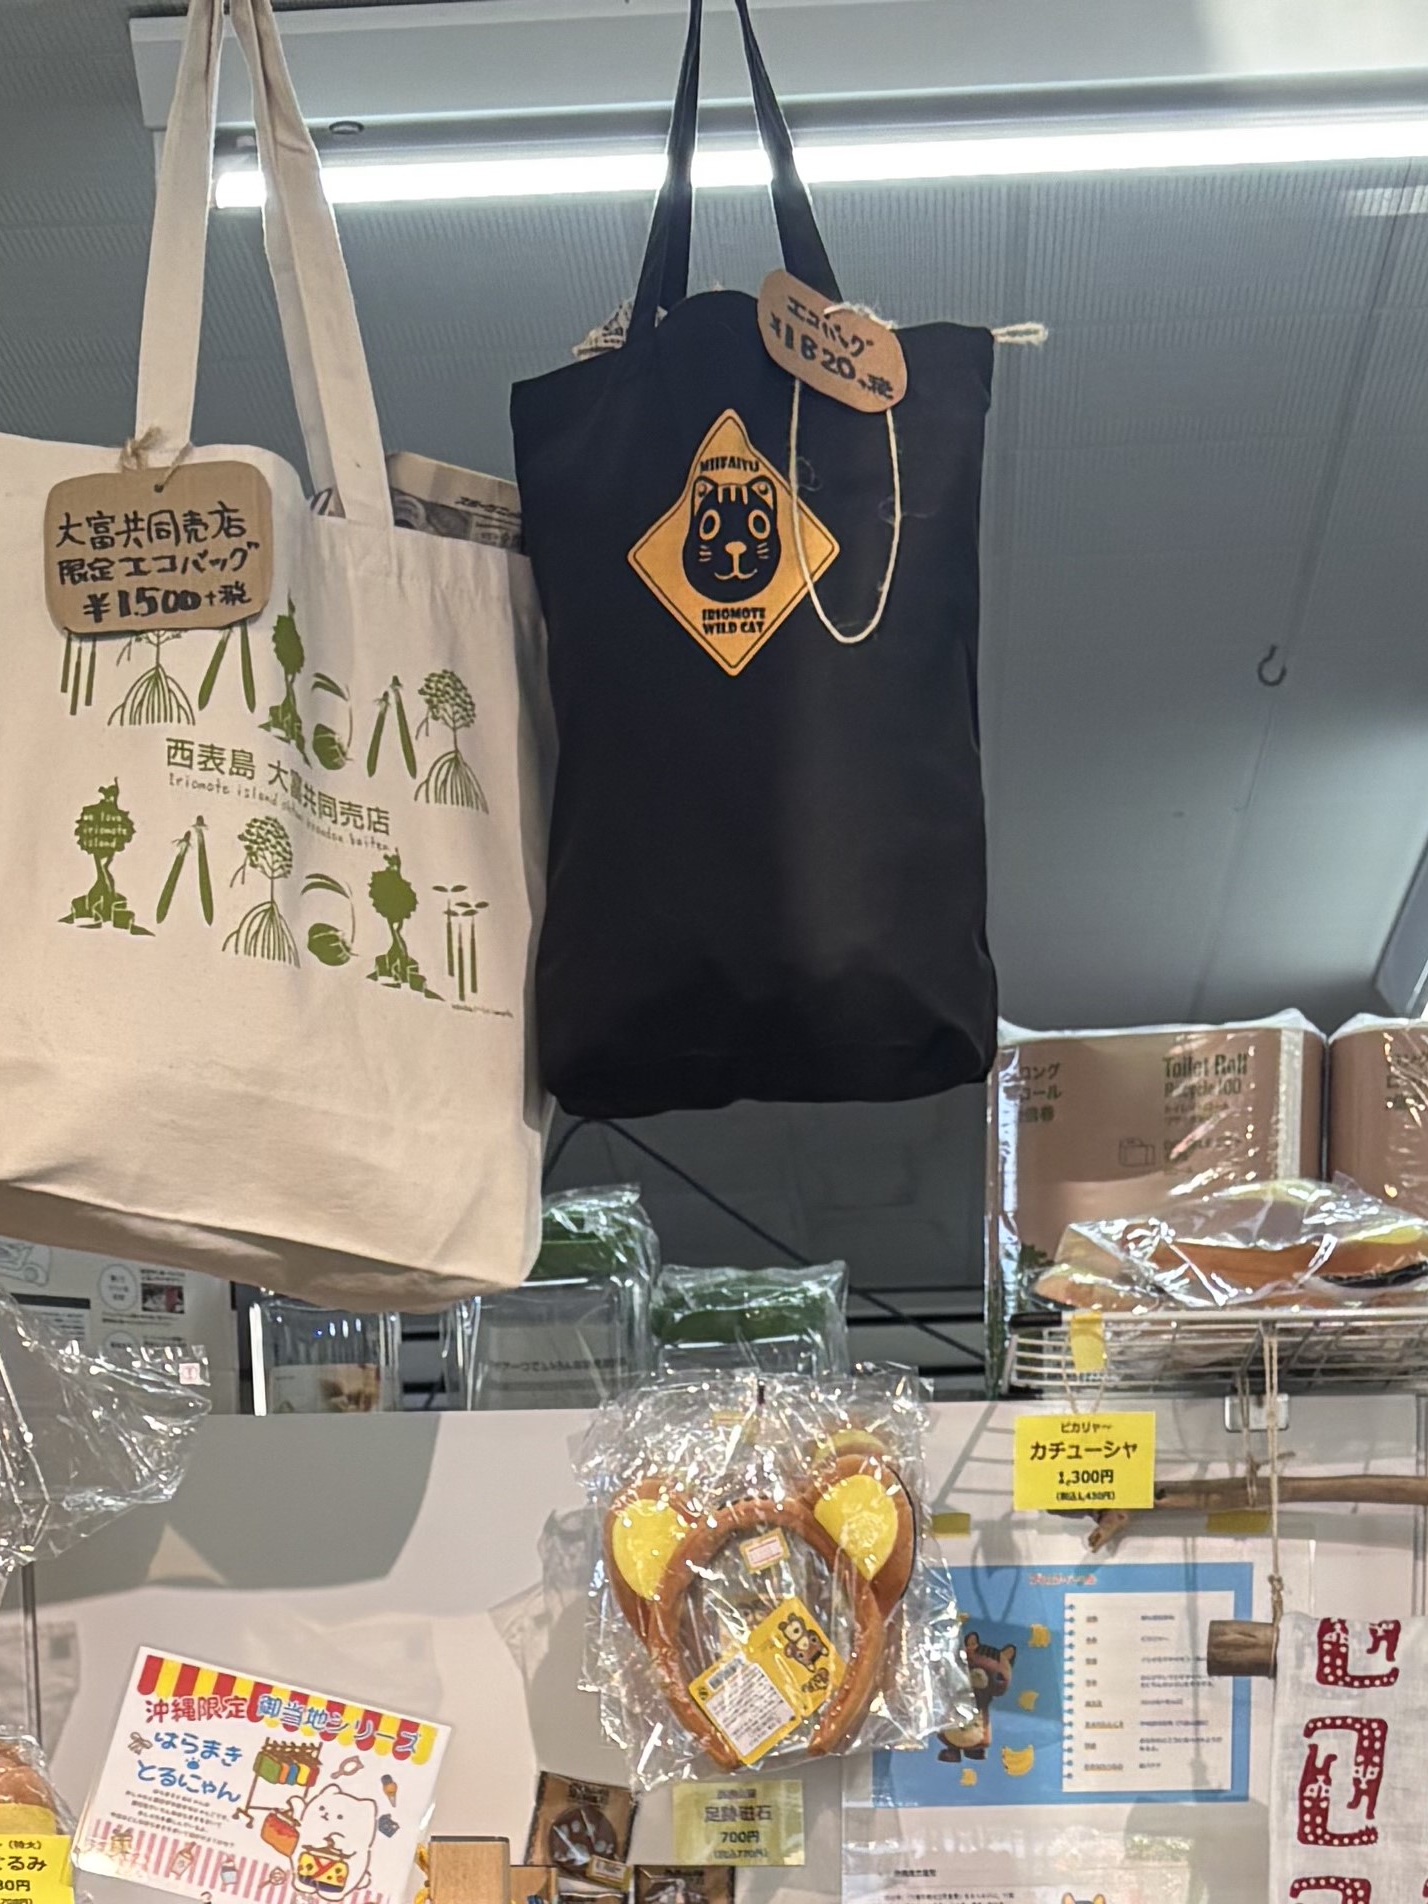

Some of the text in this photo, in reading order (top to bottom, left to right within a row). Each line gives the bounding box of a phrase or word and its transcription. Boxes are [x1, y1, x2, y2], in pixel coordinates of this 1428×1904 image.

[58, 500, 248, 551] 大富共同売店
[57, 541, 260, 586] 限定エコバッグ
[702, 607, 766, 621] IRIOMOTE
[702, 621, 765, 635] WILD CAT
[165, 737, 390, 837] 西表島 大富共同売店
[1057, 1469, 1114, 1486] 1,300円
[146, 1695, 422, 1754] 沖縄限定 御当地シリーズ
[154, 1732, 243, 1767] はらまき
[138, 1760, 241, 1803] とるにゃん
[720, 1830, 760, 1843] 700円
